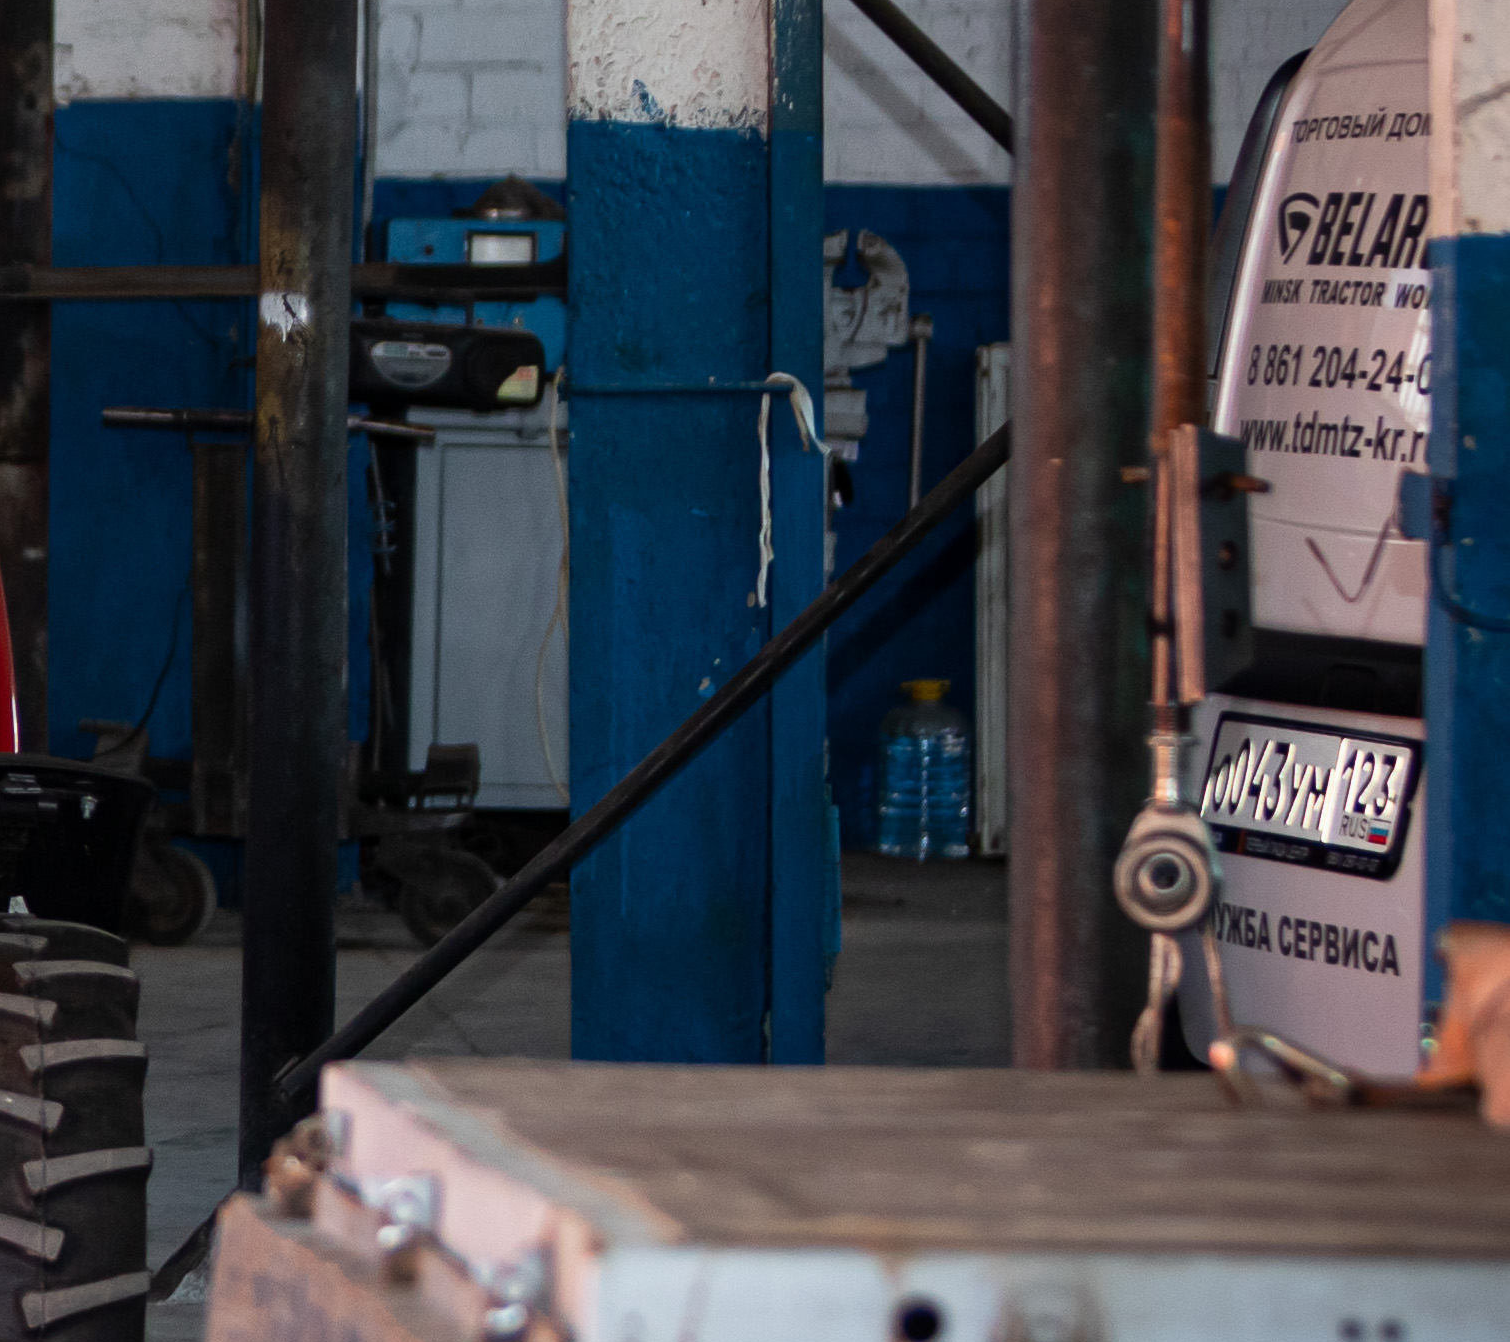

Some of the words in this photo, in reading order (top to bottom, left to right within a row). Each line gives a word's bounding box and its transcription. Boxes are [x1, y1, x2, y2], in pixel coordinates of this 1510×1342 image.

[1293, 107, 1386, 143] ТОРГОВЫЙ
[1260, 278, 1305, 304] MINSK
[1308, 279, 1386, 307] TRACTOR
[1394, 283, 1431, 309] WO
[1247, 344, 1261, 386] 8
[1263, 344, 1304, 387] 861
[1342, 749, 1402, 816] 123
[1338, 814, 1370, 840] RUS
[1213, 899, 1272, 953] УЖБА
[1278, 915, 1400, 977] СЕРВИСА
